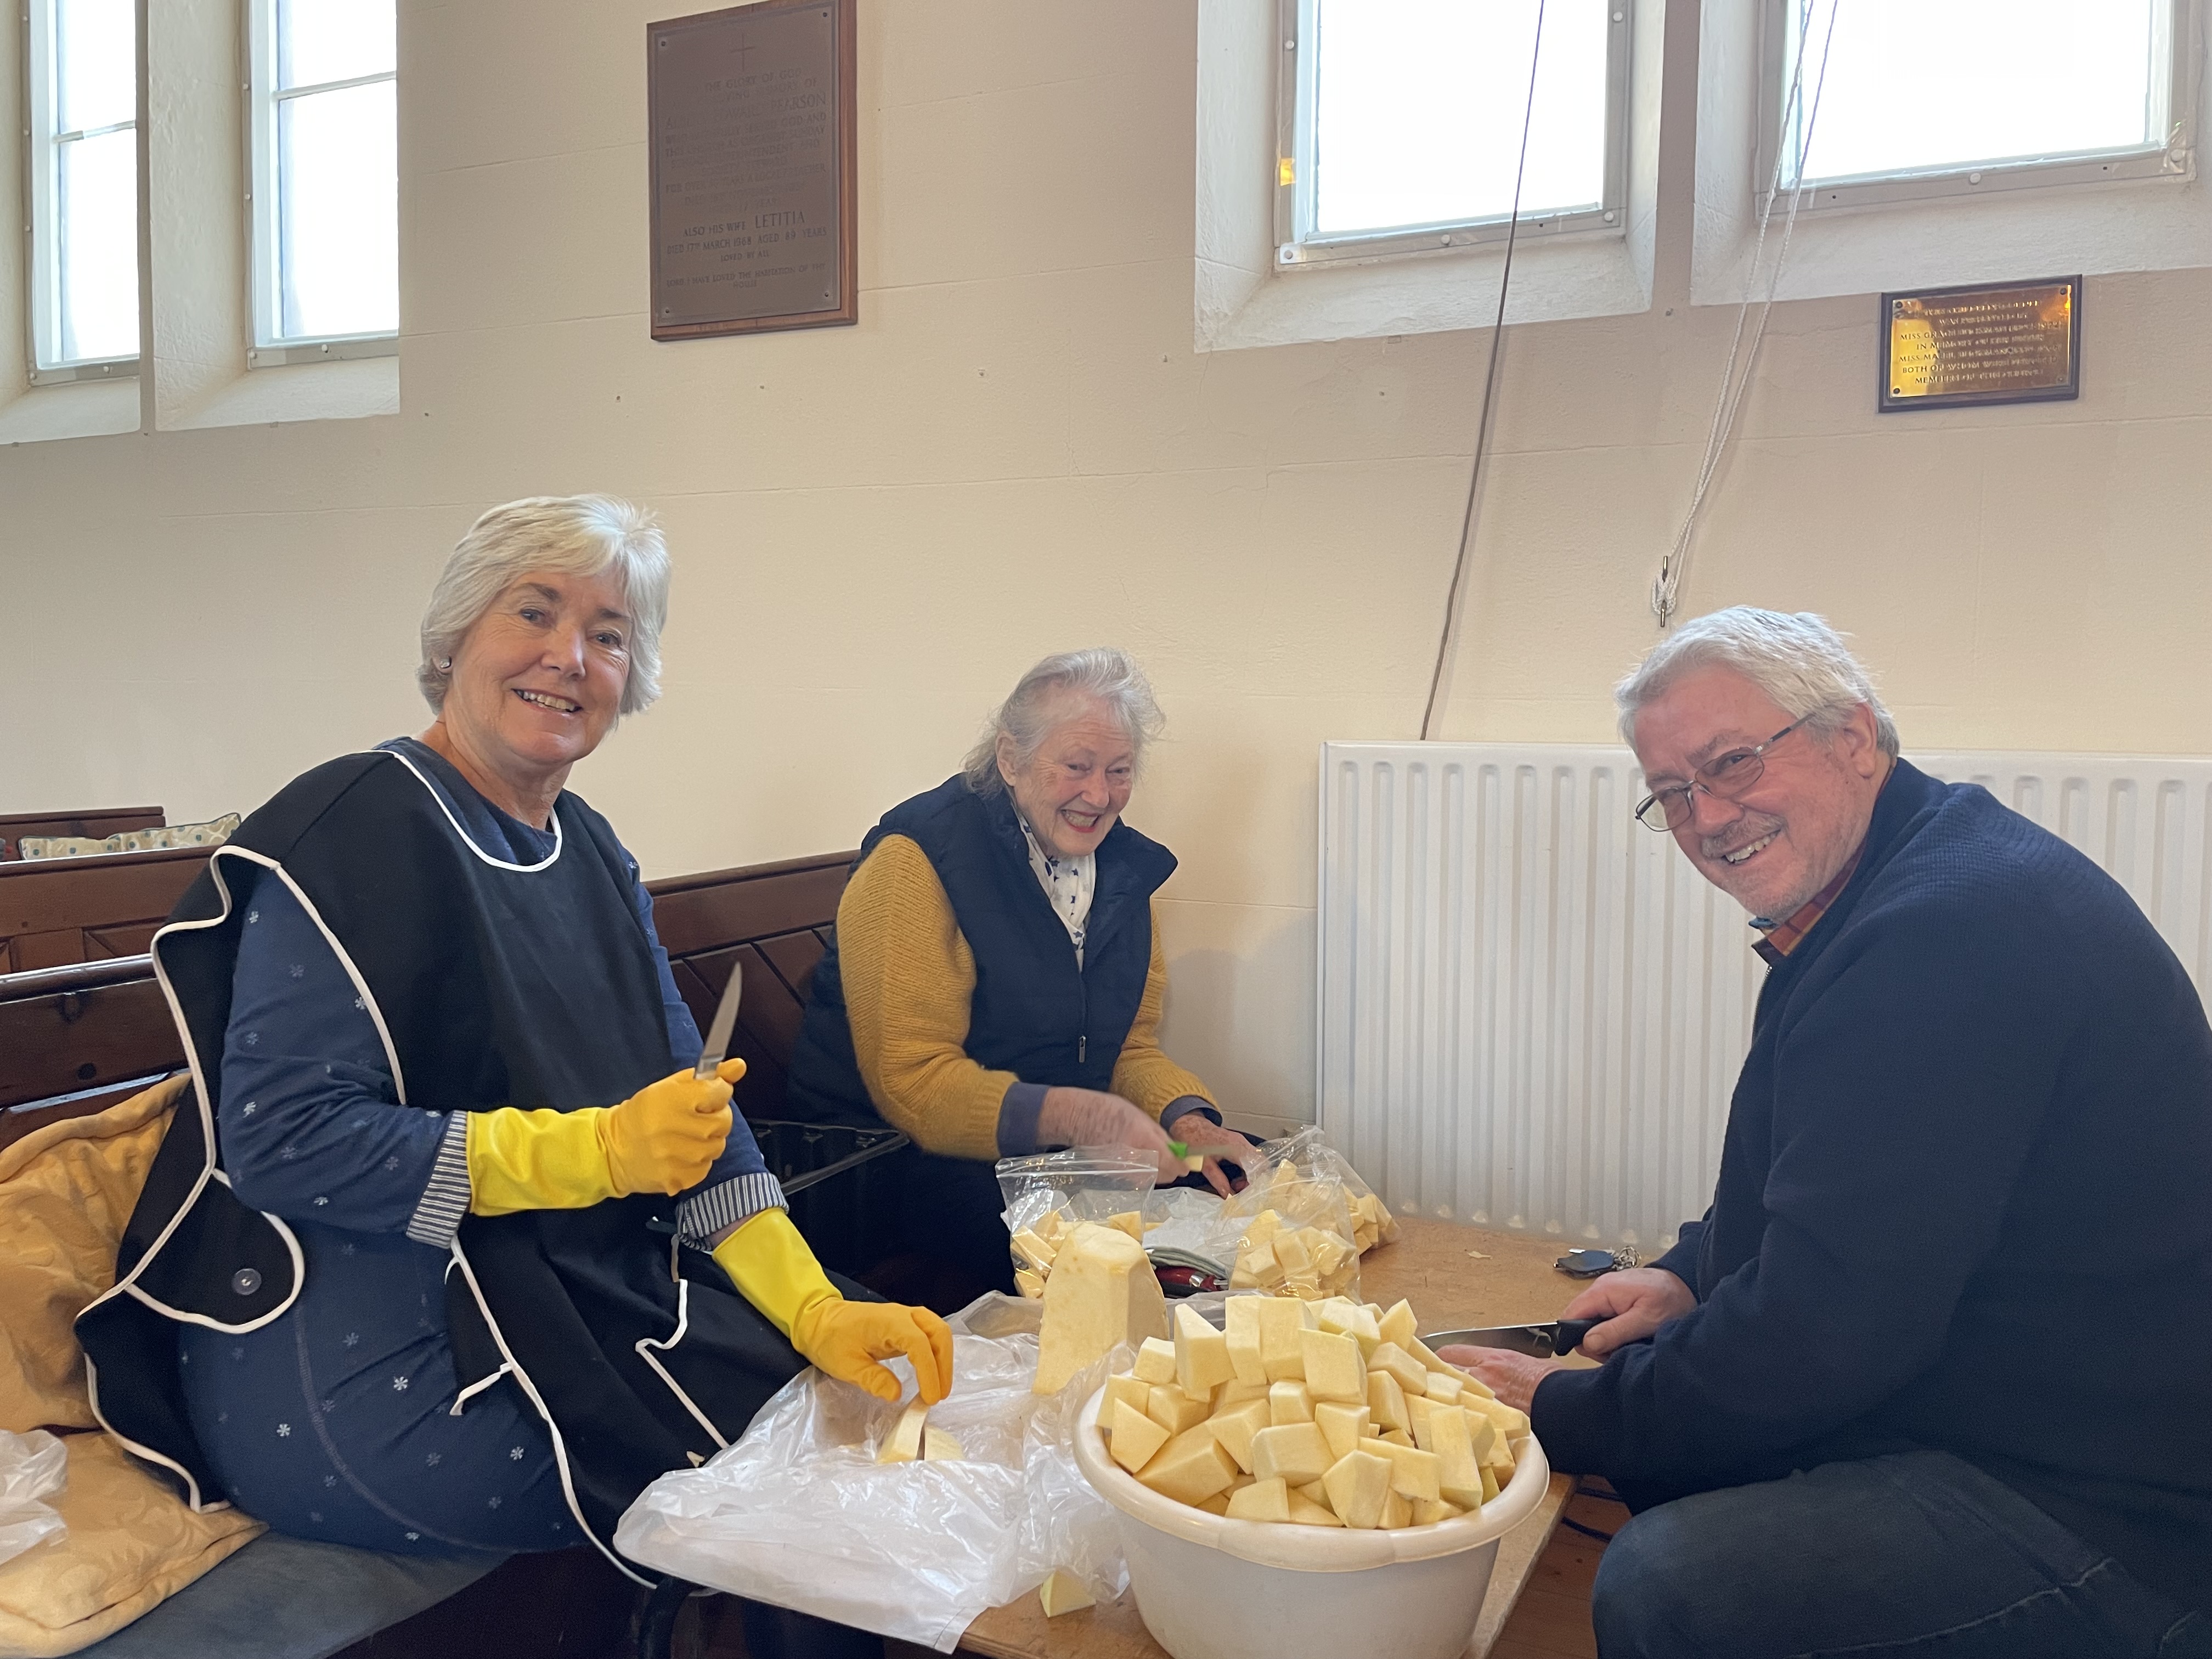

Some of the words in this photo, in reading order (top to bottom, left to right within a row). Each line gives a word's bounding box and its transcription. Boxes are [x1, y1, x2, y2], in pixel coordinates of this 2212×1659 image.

[726, 76, 756, 88] GLORY
[762, 72, 774, 82] OF
[780, 67, 801, 80] GOD
[804, 77, 817, 88] OF
[806, 111, 827, 123] AND
[683, 225, 705, 237] ALSO
[709, 223, 724, 234] HIS
[726, 221, 746, 232] WIFE
[755, 211, 805, 229] LETITIA
[667, 244, 685, 255] DIED
[703, 239, 731, 251] MARCH
[733, 236, 752, 247] 1968
[757, 233, 780, 245] AGED
[785, 230, 797, 241] 89
[802, 226, 828, 239] YEARS
[720, 252, 743, 263] LOVED
[747, 251, 755, 259] BY
[757, 250, 770, 258] ALL
[667, 278, 685, 288] LORD
[692, 275, 710, 285] HAVE
[713, 273, 735, 284] LOVED
[738, 270, 752, 280] THE
